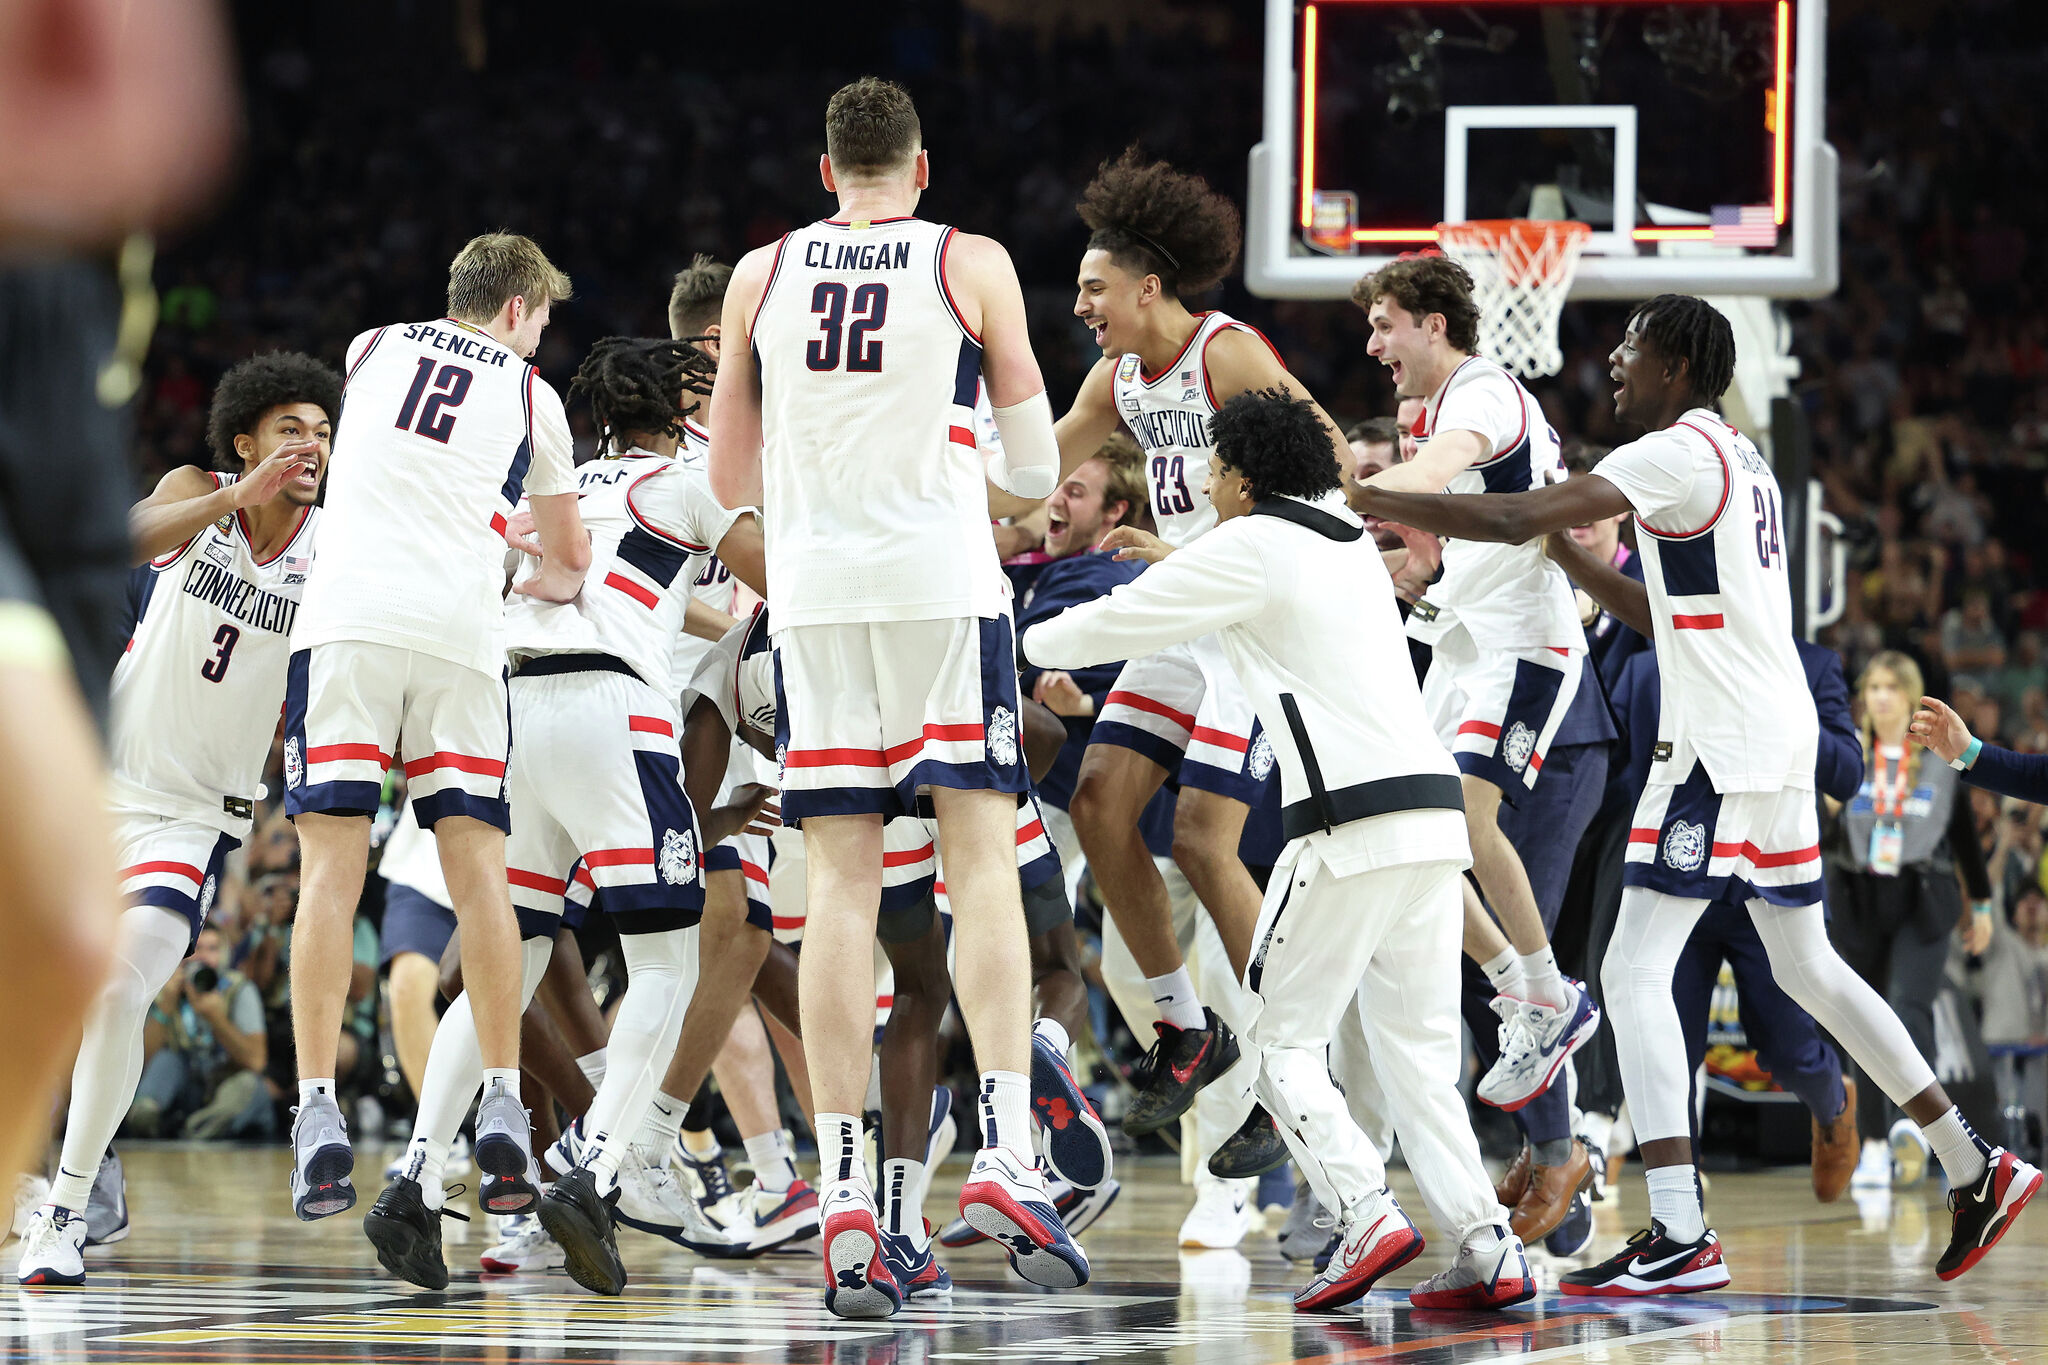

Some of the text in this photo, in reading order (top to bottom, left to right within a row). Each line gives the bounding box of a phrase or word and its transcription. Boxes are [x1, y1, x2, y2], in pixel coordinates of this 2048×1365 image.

[805, 240, 911, 270] CLINGAN
[403, 324, 508, 367] SPENCER
[805, 281, 889, 372] 32
[394, 356, 474, 444] 12
[1152, 455, 1195, 516] 23
[1753, 485, 1781, 570] 24
[201, 623, 240, 684] 3
